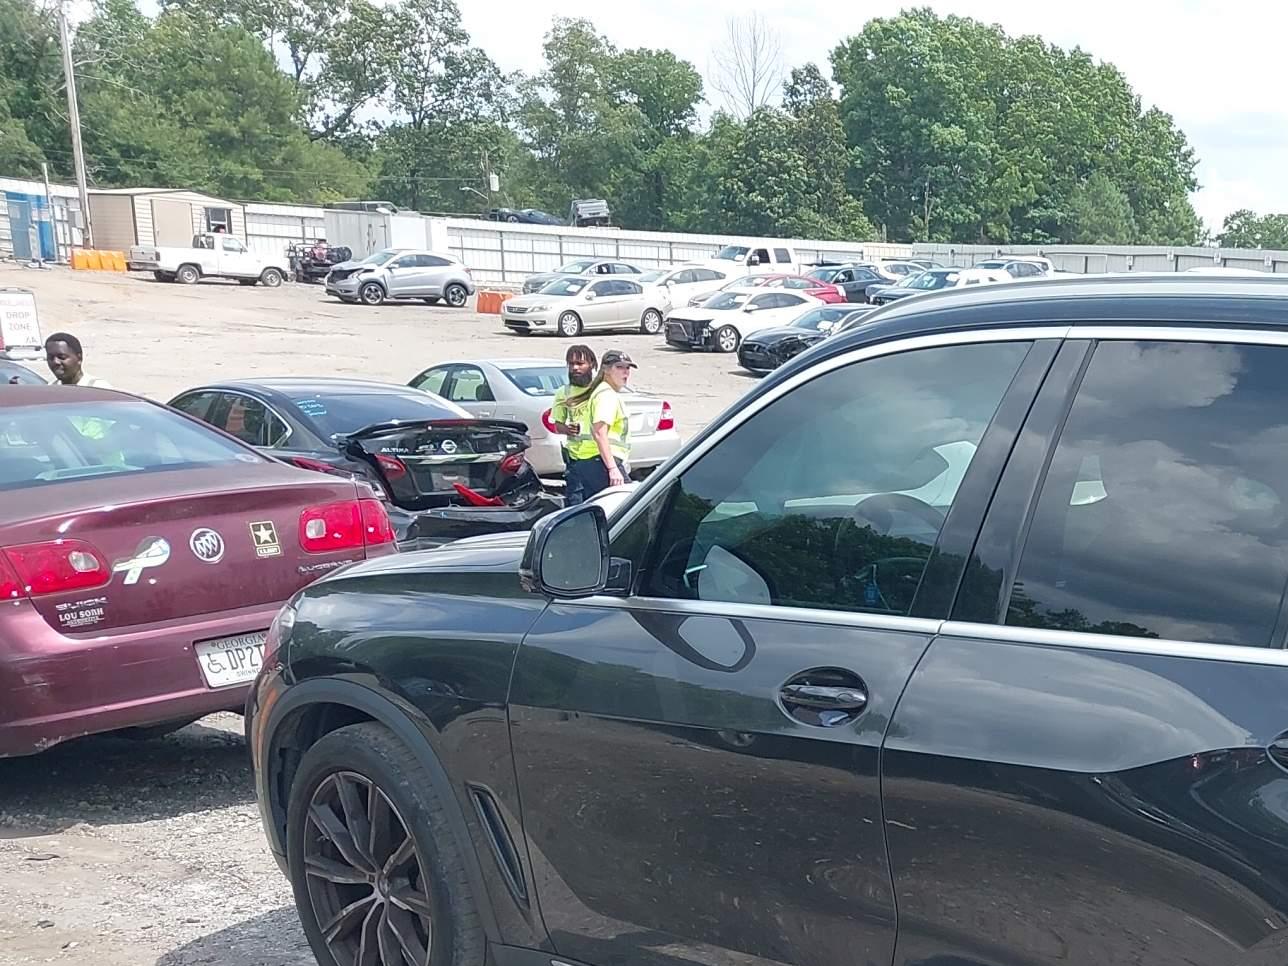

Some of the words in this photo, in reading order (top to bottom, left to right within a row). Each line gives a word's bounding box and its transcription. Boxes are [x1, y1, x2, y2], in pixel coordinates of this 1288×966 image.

[6, 311, 31, 319] DROP
[58, 612, 78, 622] LOU
[216, 632, 265, 650] GEORGIA
